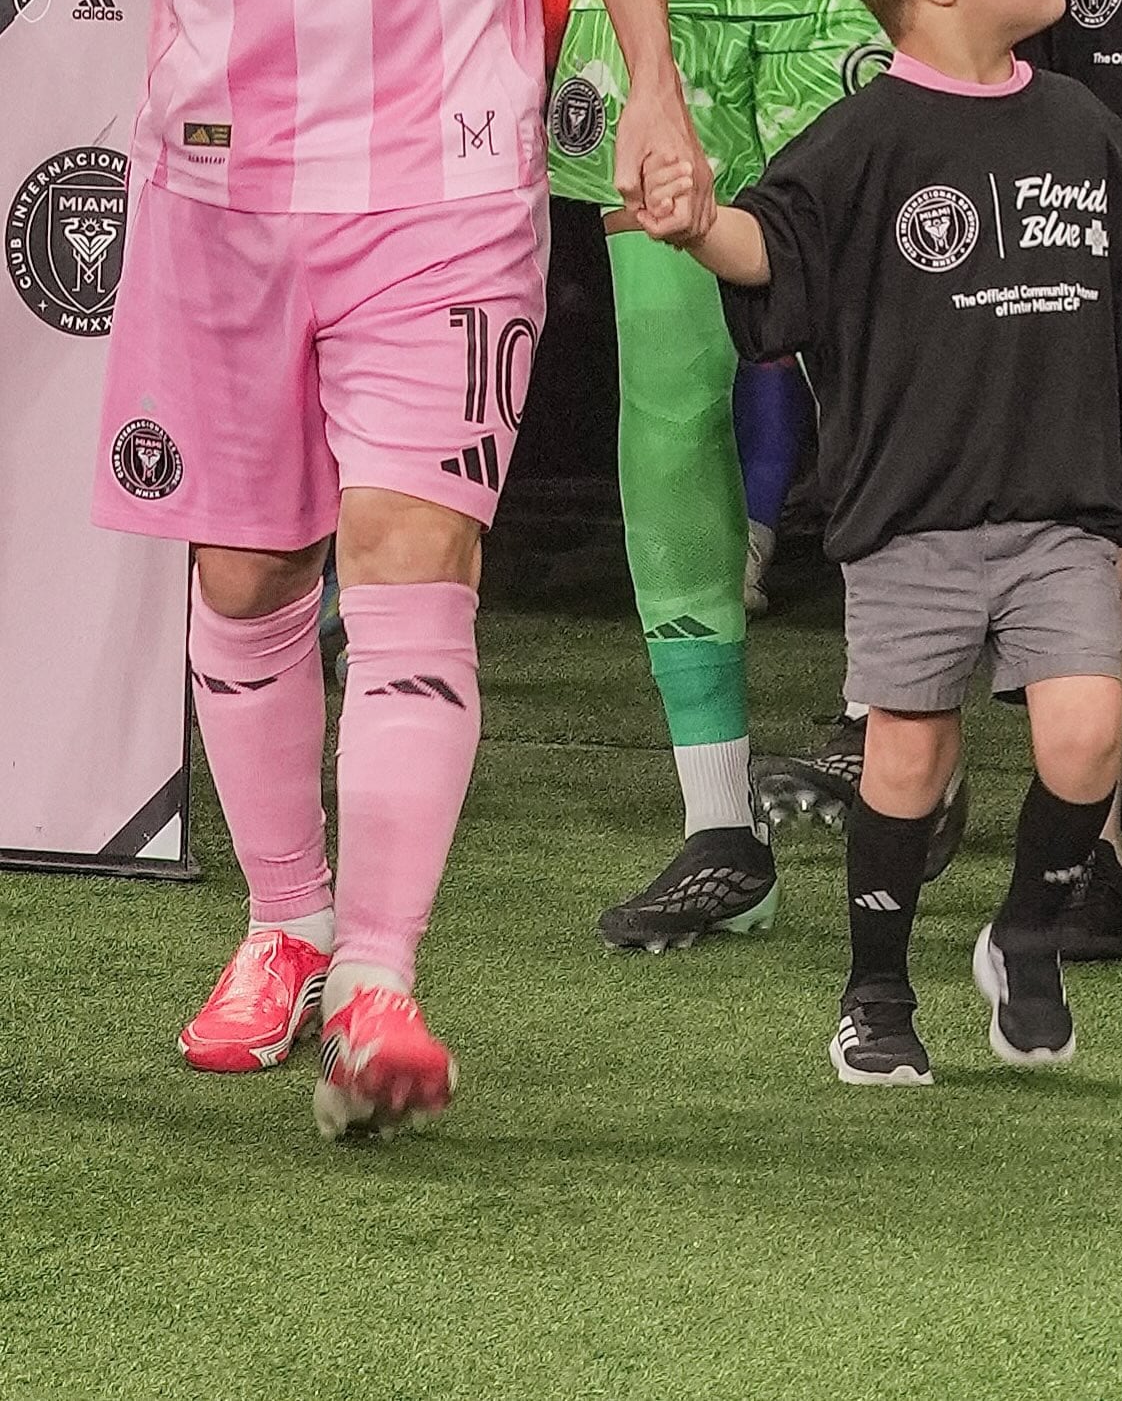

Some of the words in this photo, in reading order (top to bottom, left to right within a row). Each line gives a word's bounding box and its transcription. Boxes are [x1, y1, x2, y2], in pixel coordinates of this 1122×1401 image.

[72, 6, 124, 21] adidas
[1093, 52, 1111, 64] The
[11, 152, 127, 228] INTERNACION
[58, 196, 125, 214] MIAMI
[919, 205, 951, 222] MIAMI
[1018, 210, 1081, 249] Blue
[10, 237, 32, 290] CLUB
[951, 293, 977, 309] The
[976, 285, 1020, 305] Official
[1020, 282, 1076, 299] Community
[995, 301, 1008, 317] of
[1032, 298, 1063, 313] Miami
[1063, 297, 1081, 311] CF
[449, 307, 538, 433] 10
[135, 438, 162, 449] MIAMI
